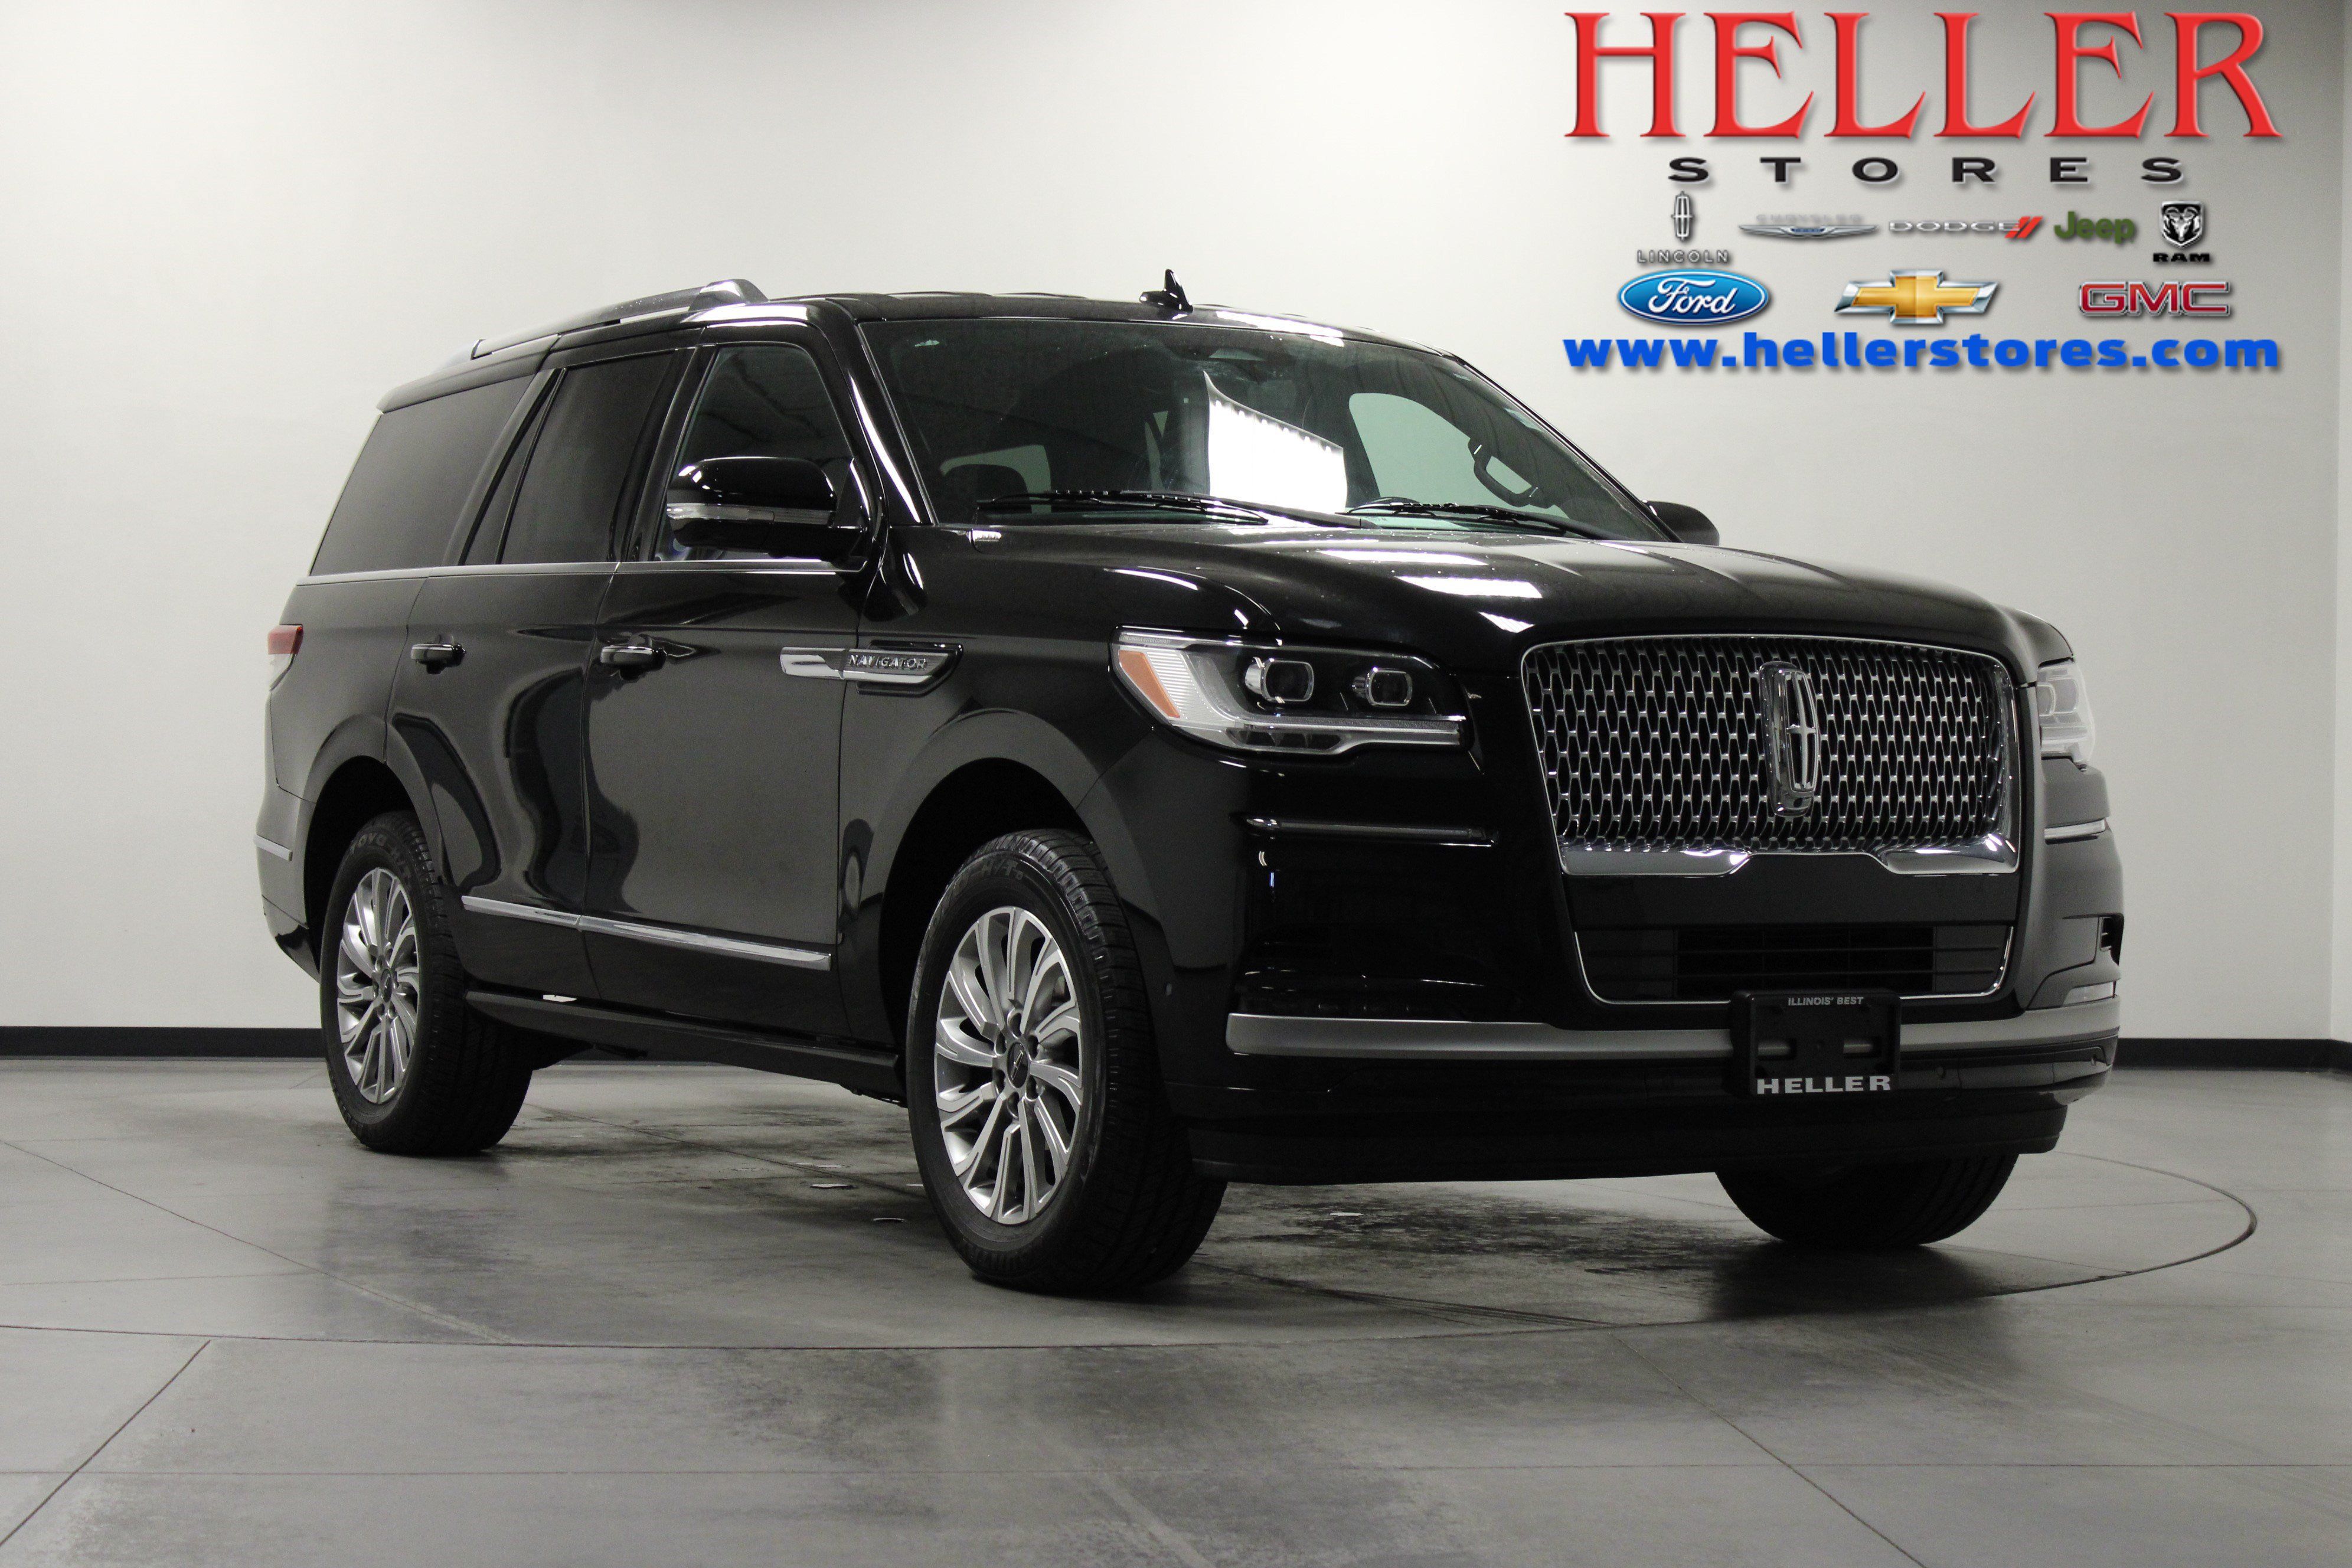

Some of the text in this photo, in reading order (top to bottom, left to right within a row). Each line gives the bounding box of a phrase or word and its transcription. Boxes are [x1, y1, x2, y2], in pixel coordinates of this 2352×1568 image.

[848, 654, 927, 669] NAVIGATOR
[1788, 997, 1864, 1005] ILLINOIS' BEST
[1757, 1076, 1890, 1094] HELLER
